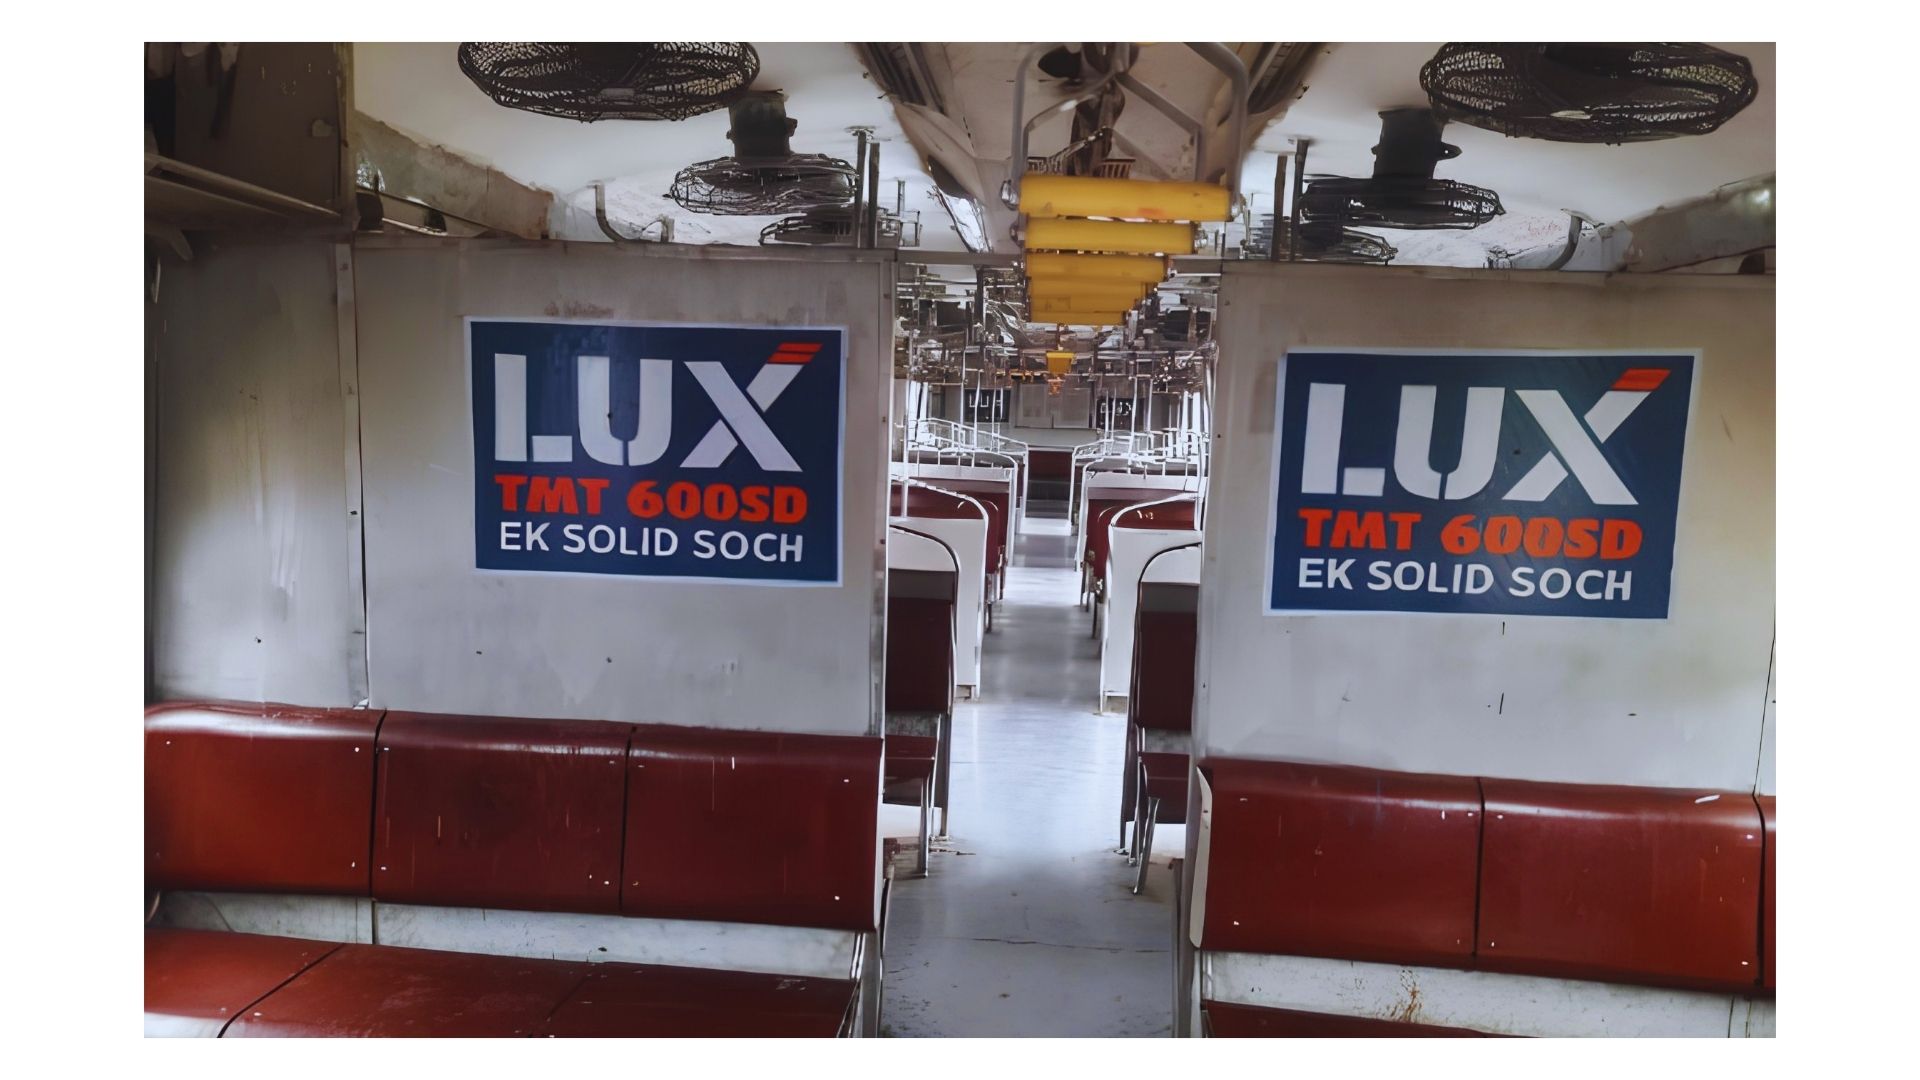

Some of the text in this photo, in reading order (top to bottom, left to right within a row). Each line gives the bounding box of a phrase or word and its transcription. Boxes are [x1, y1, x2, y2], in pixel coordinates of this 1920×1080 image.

[494, 343, 820, 472] LUX
[1301, 368, 1669, 506] LUX
[495, 475, 807, 524] TMT 600SD
[500, 521, 803, 562] EK SOLID SOCH
[1298, 508, 1643, 560] TMT 600SD
[1298, 557, 1632, 601] EK SOLID SOCH
